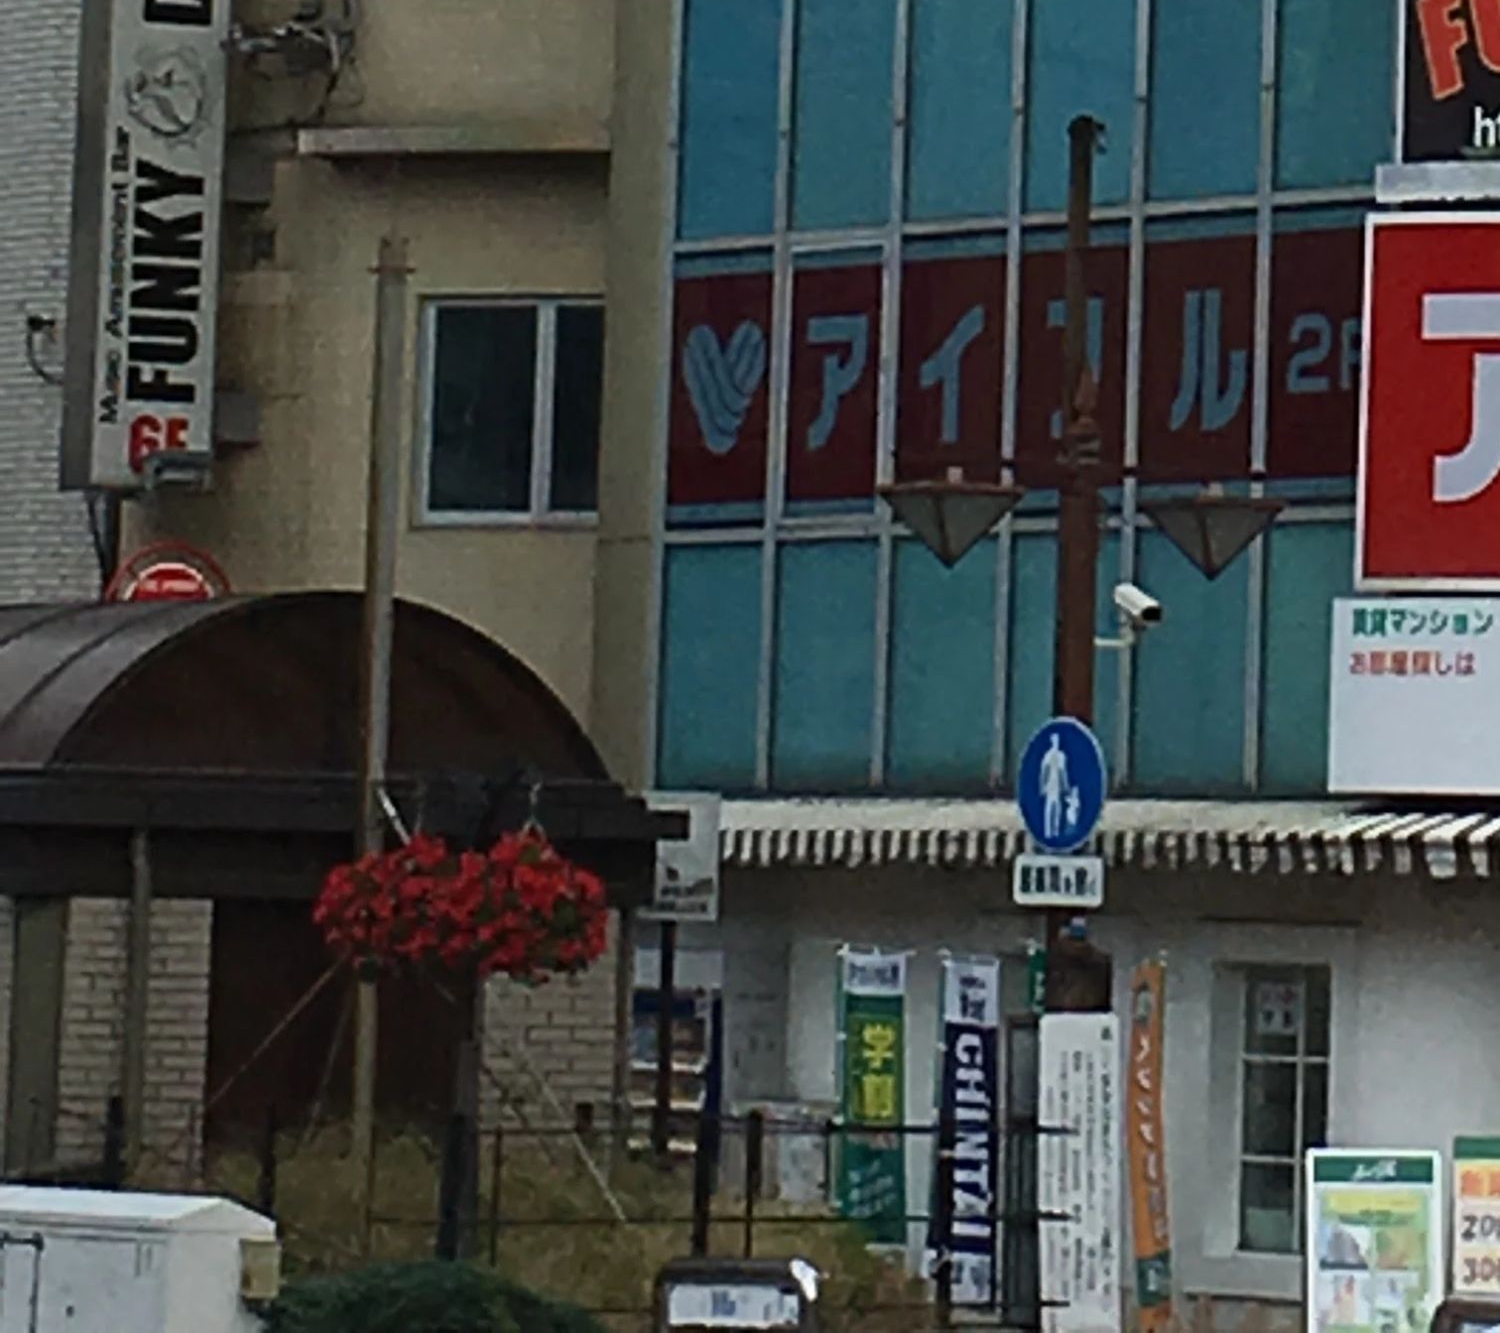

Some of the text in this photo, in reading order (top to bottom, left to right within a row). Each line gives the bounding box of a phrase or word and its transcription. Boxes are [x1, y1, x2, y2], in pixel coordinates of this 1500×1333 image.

[127, 157, 207, 404] FUNKY
[1348, 649, 1477, 678] お部屋探しは
[951, 1033, 994, 1237] CHINTAI
